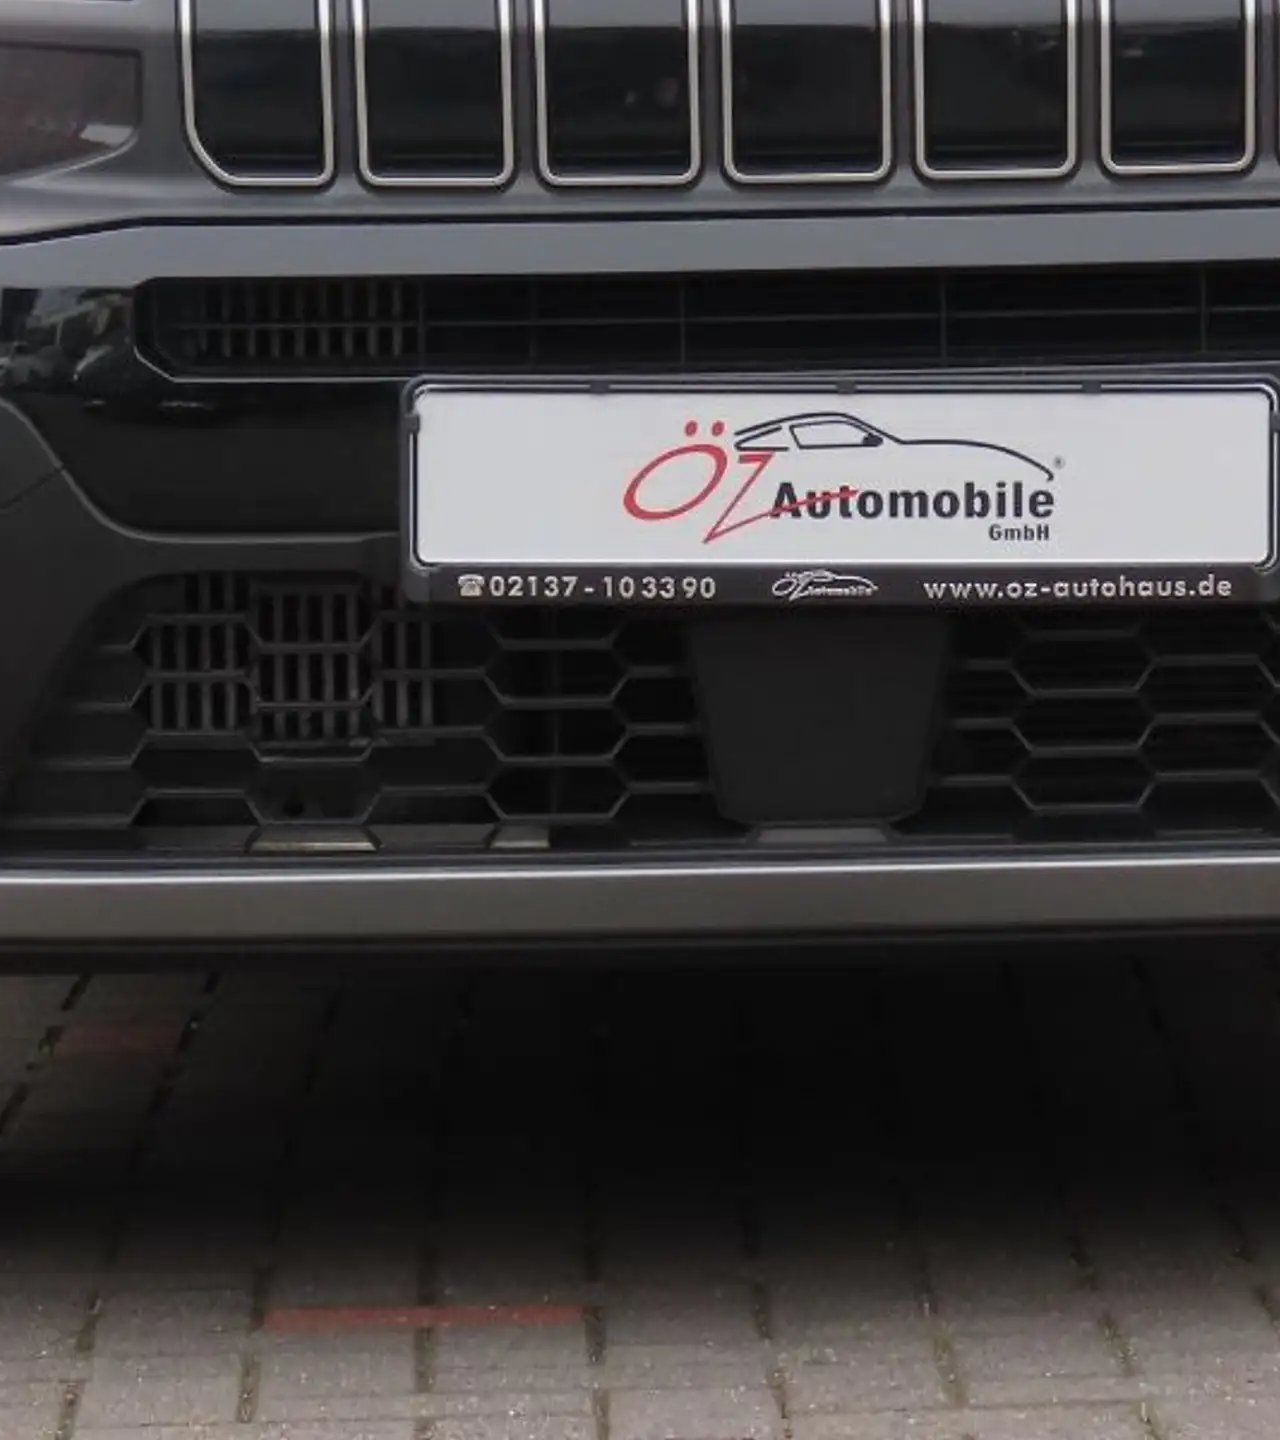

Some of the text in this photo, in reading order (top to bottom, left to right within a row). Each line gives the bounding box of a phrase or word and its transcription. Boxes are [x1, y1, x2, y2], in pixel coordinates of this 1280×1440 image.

[770, 480, 1055, 519] Automobile
[988, 523, 1050, 541] GmbH
[923, 574, 1233, 599] www.oz-autohaus.de
